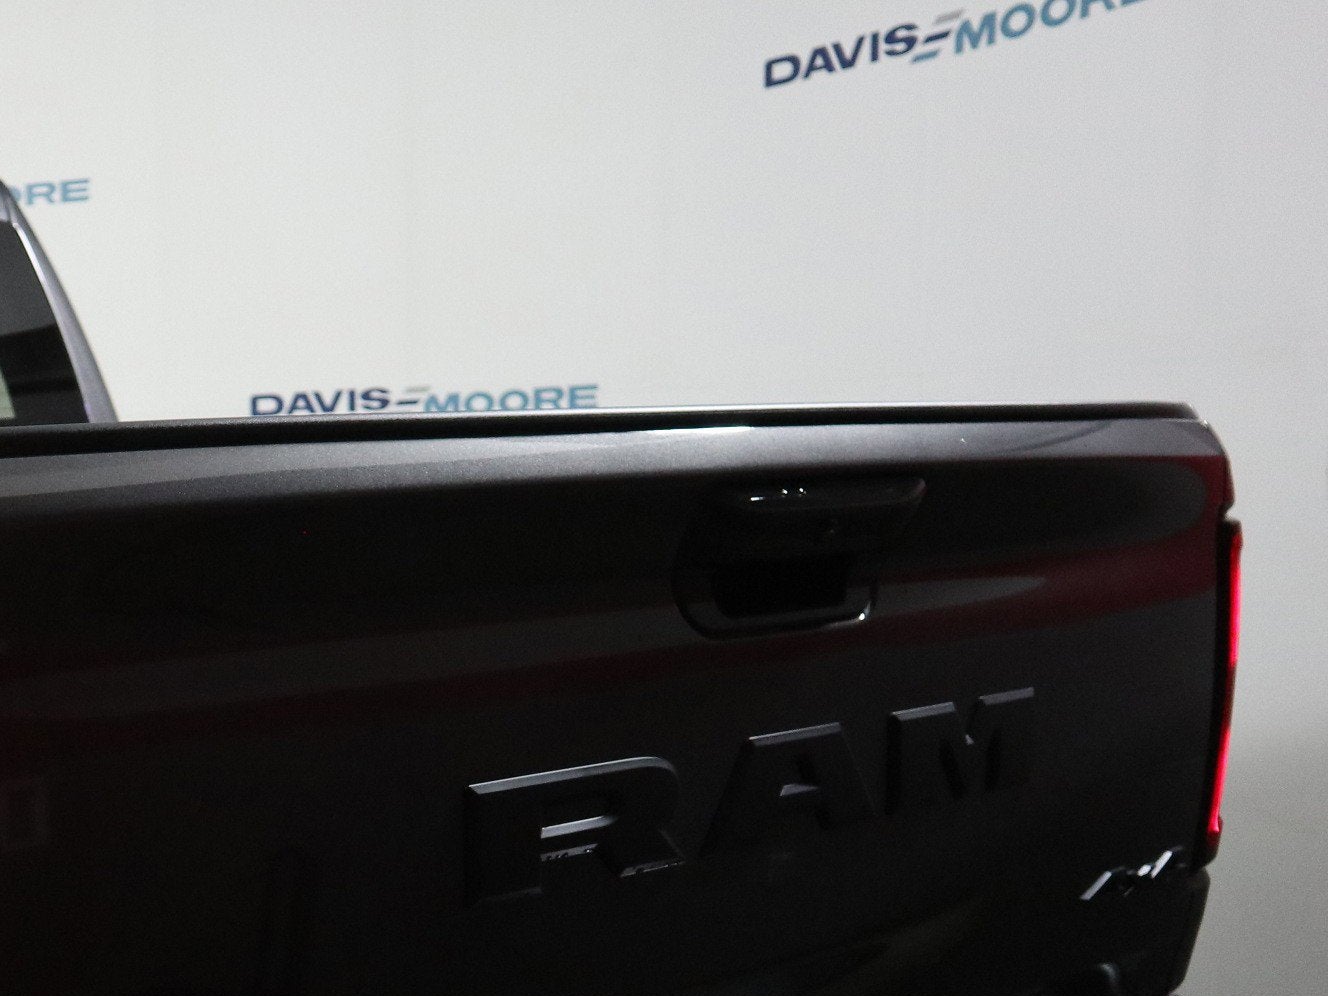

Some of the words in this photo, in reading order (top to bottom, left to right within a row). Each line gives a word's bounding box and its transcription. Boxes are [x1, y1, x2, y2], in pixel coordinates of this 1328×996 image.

[764, 23, 918, 88] DAVIS
[954, 0, 1144, 54] MOO
[251, 387, 390, 416] DAVIS
[425, 384, 599, 413] MOORE
[464, 687, 1035, 908] RAM
